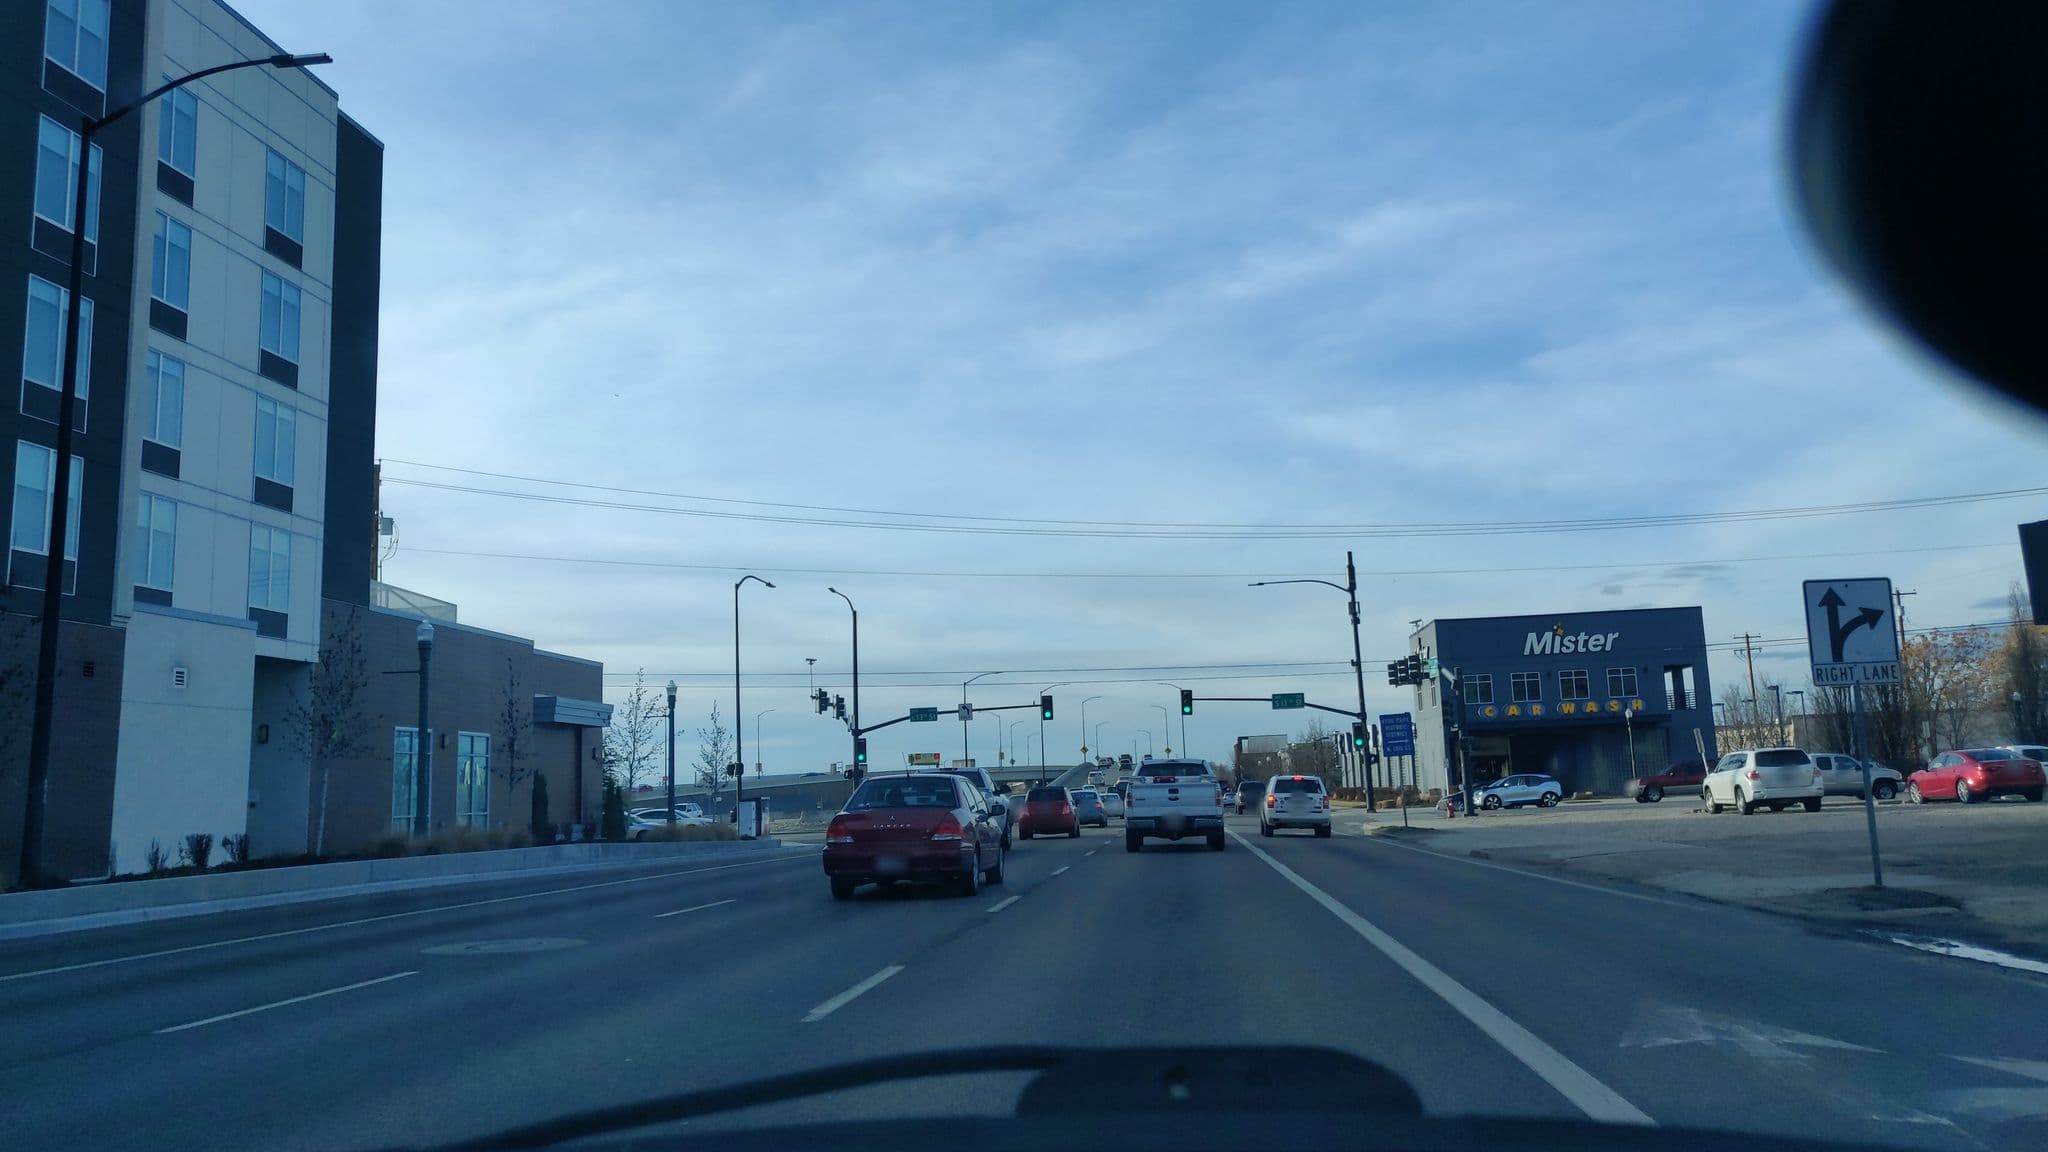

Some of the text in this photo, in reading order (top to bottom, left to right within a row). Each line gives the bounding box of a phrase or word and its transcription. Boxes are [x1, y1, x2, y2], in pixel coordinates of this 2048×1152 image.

[1523, 628, 1619, 655] Mister
[1815, 664, 1898, 682] RIGHT LANE
[1484, 698, 1643, 718] CAR WASH
